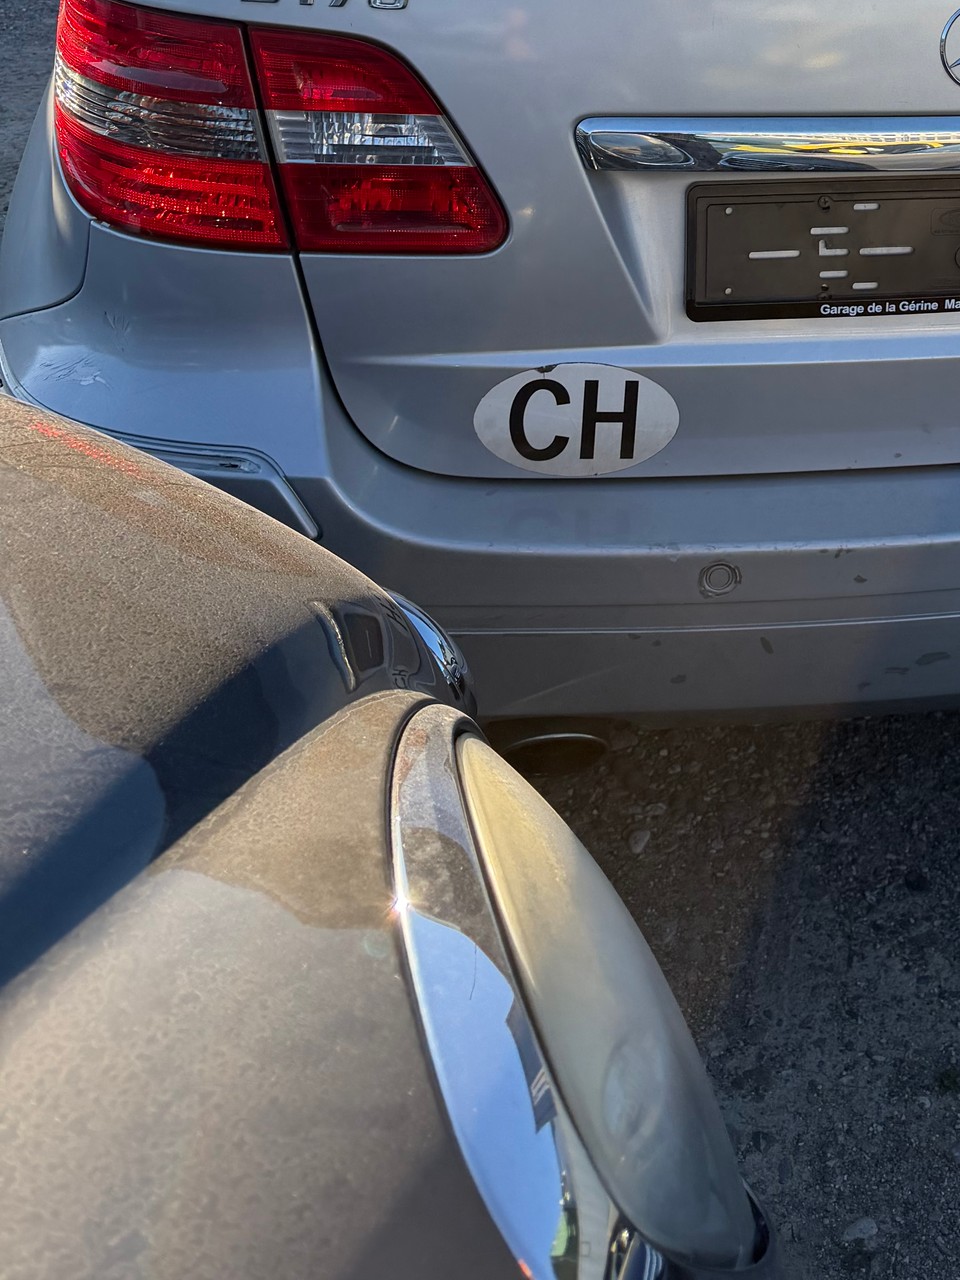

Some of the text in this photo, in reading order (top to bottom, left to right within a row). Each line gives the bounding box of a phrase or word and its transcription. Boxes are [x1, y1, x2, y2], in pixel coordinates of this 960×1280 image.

[820, 304, 865, 316] Garage
[867, 302, 883, 313] de
[885, 302, 896, 312] la
[899, 300, 939, 312] Gérine
[509, 378, 640, 462] CH
